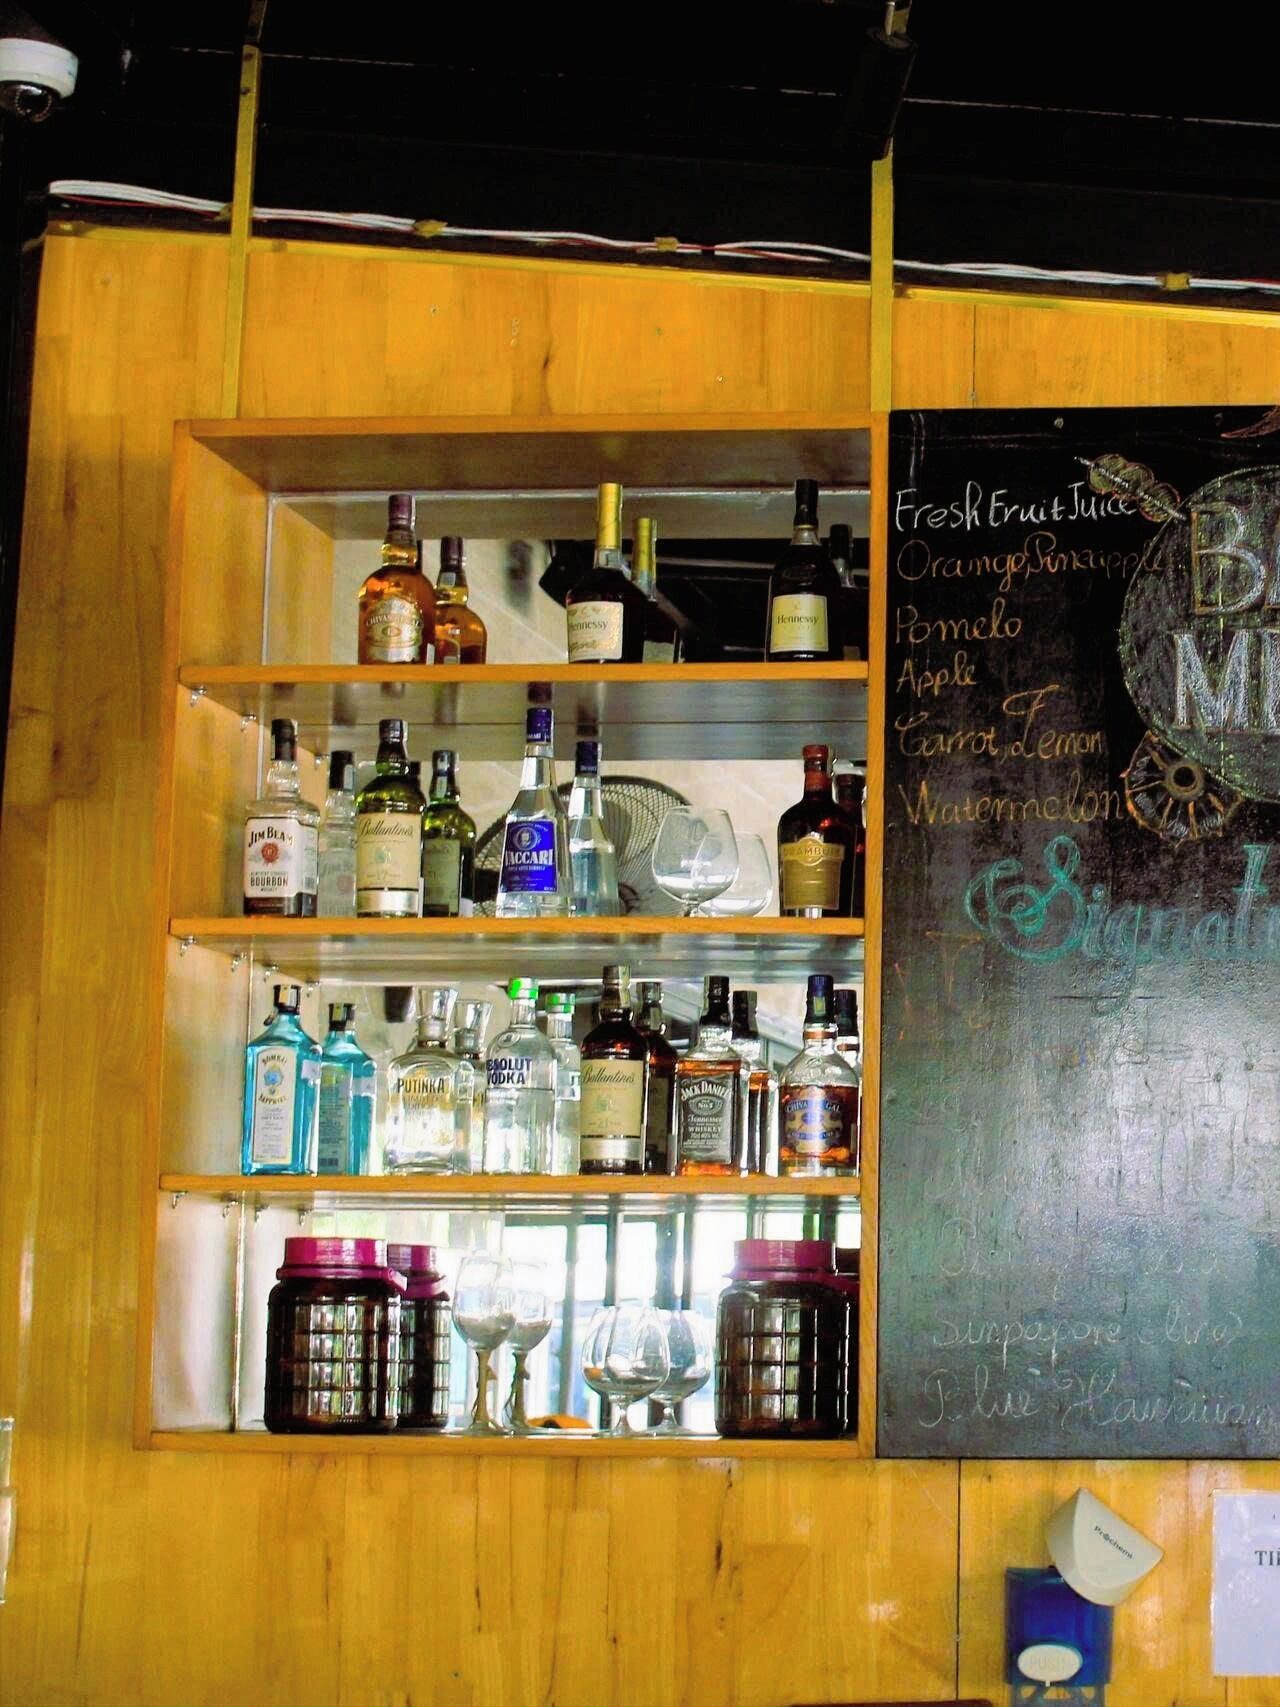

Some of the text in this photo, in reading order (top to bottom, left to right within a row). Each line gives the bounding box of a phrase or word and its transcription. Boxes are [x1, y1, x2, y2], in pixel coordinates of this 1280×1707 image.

[896, 481, 1138, 531] Fresh Fruit Juice
[777, 614, 820, 626] Hennessy
[896, 597, 1023, 645] Pomelo
[896, 651, 978, 697] Apple
[1002, 684, 1102, 760] Lemon
[898, 772, 1124, 826] Watermelon
[248, 830, 266, 848] JIM
[250, 876, 288, 888] BOURBON
[398, 1077, 445, 1094] PUTINKA
[681, 1086, 702, 1102] JACK
